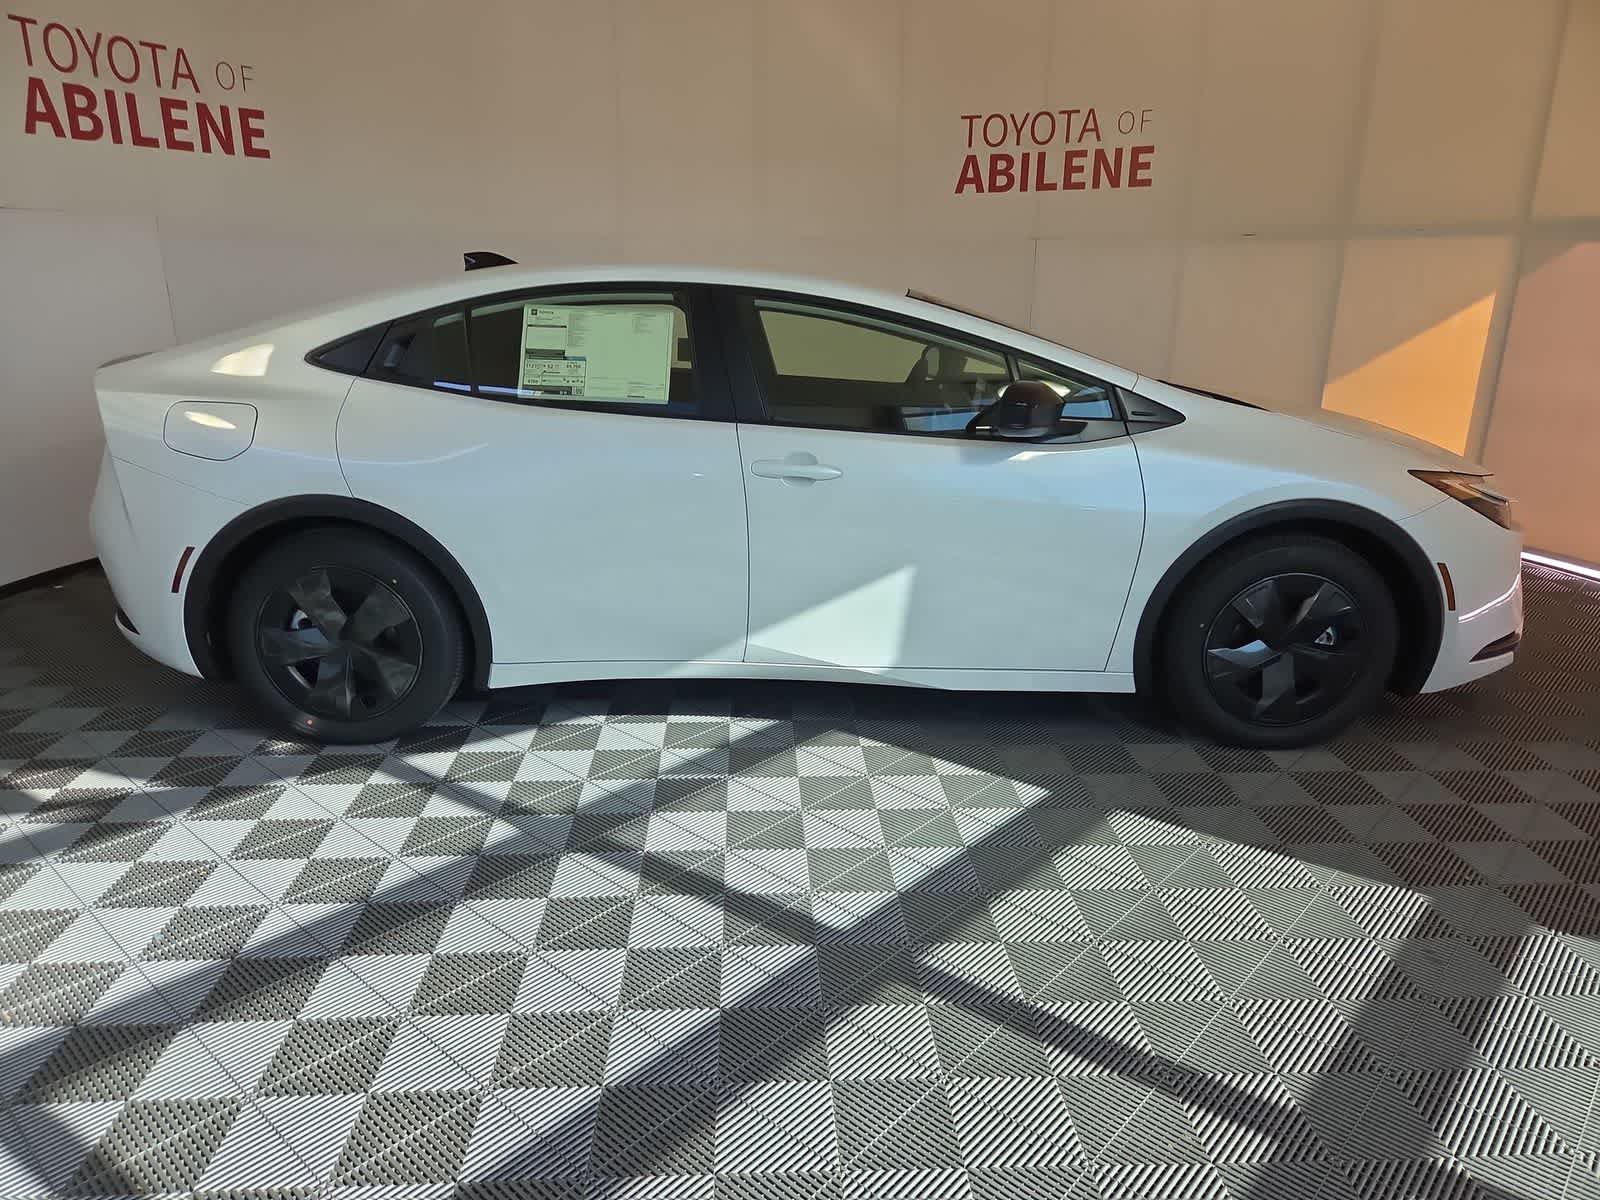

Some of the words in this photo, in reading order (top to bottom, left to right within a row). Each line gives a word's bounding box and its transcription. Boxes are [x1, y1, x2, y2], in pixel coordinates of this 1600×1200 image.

[8, 14, 200, 93] TOYOTA
[216, 61, 254, 92] OF
[25, 77, 270, 159] ABILENE
[961, 108, 1102, 148] TOYOTA
[1117, 109, 1153, 134] OF
[954, 145, 1155, 194] ABILENE
